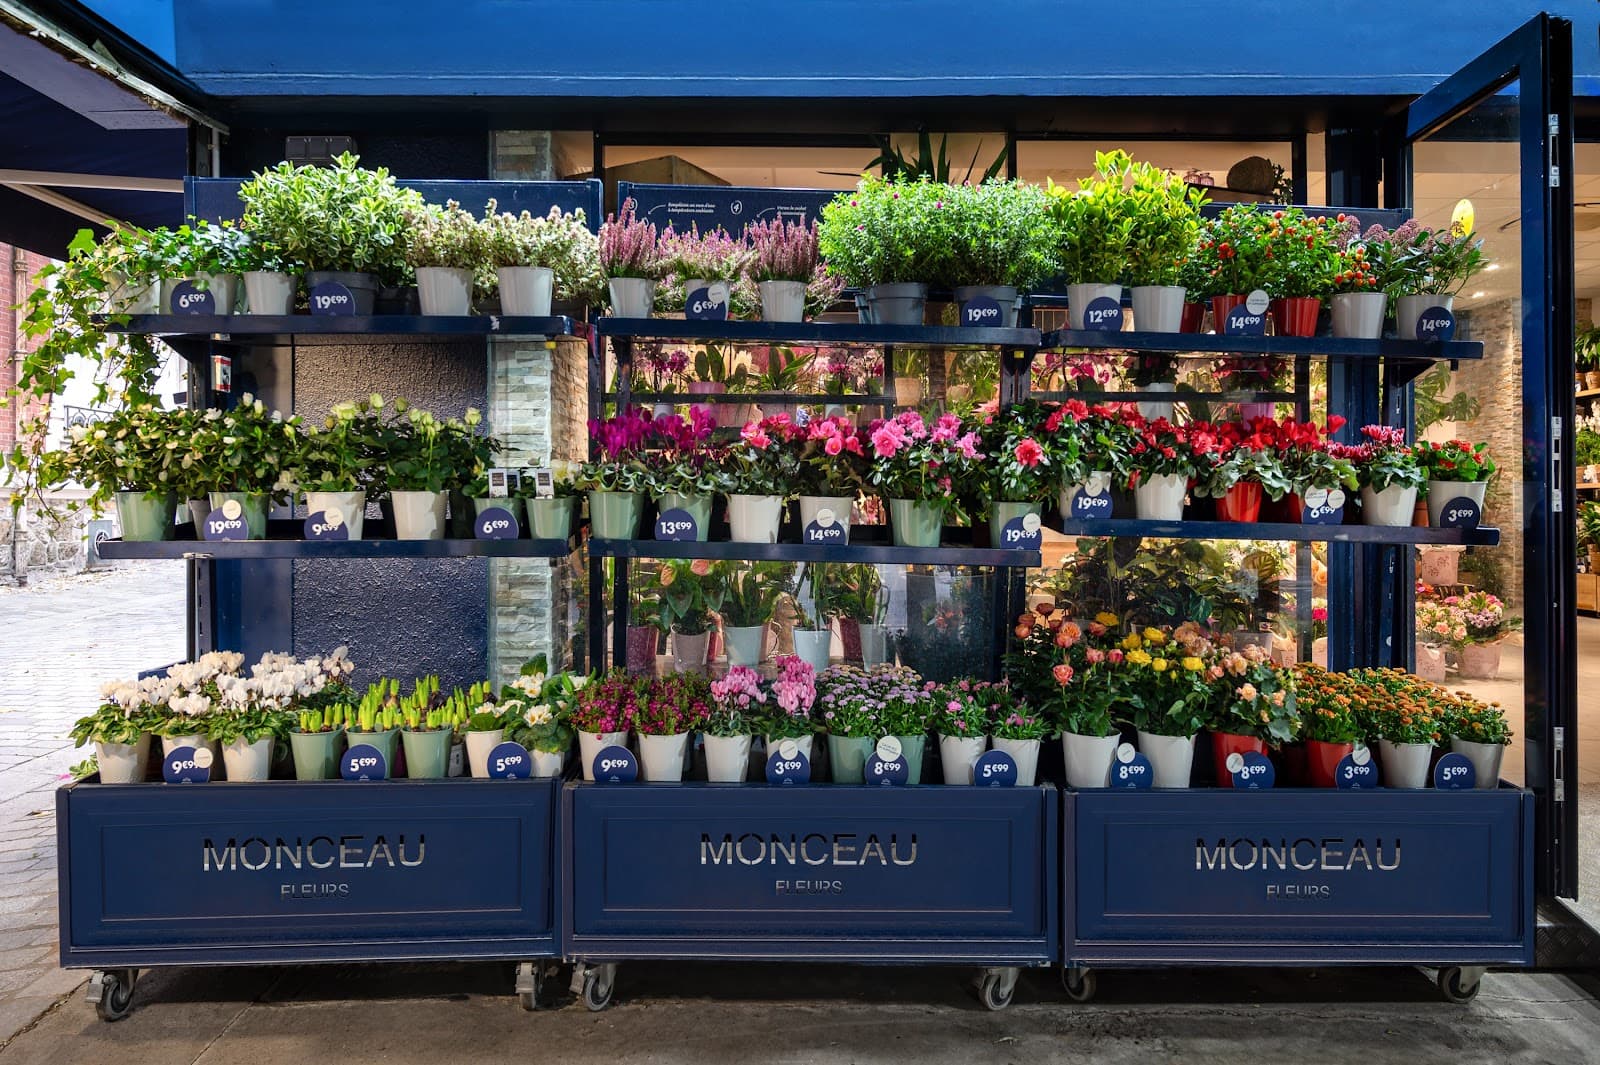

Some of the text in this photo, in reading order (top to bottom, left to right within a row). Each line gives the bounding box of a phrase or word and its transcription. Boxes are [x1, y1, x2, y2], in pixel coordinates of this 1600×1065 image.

[180, 294, 205, 308] 6€99
[315, 296, 347, 309] 19€99
[693, 300, 719, 313] 6€99
[967, 309, 997, 321] 19€99
[1088, 309, 1118, 322] 12€99
[1231, 316, 1260, 329] 14€99
[1422, 319, 1451, 331] 14€99
[1078, 496, 1107, 509] 19€99
[1310, 506, 1336, 518] 6€99
[1448, 510, 1473, 522] 3€99
[209, 520, 242, 534] 19€99
[483, 520, 509, 533] 6€99
[660, 522, 692, 534] 13€99
[809, 529, 841, 541] 14€99
[1007, 529, 1037, 542] 19€99
[350, 758, 377, 772] 5€99
[496, 755, 522, 772] 5€99
[602, 759, 628, 772] 9€99
[775, 761, 802, 775] 3€99
[874, 762, 901, 775] 8€99
[982, 764, 1008, 777] 5€99
[1119, 765, 1145, 778] 8€99
[1240, 765, 1266, 778] 8€99
[1345, 766, 1370, 779] 3€99
[1443, 767, 1468, 779] 5€99
[203, 834, 425, 872] MONCEAU
[700, 833, 918, 866] MONCEAU
[1195, 838, 1401, 871] MONCEAU
[281, 883, 350, 900] FLEURS
[775, 880, 843, 896] FLEURS
[1266, 884, 1331, 900] FLEURS
